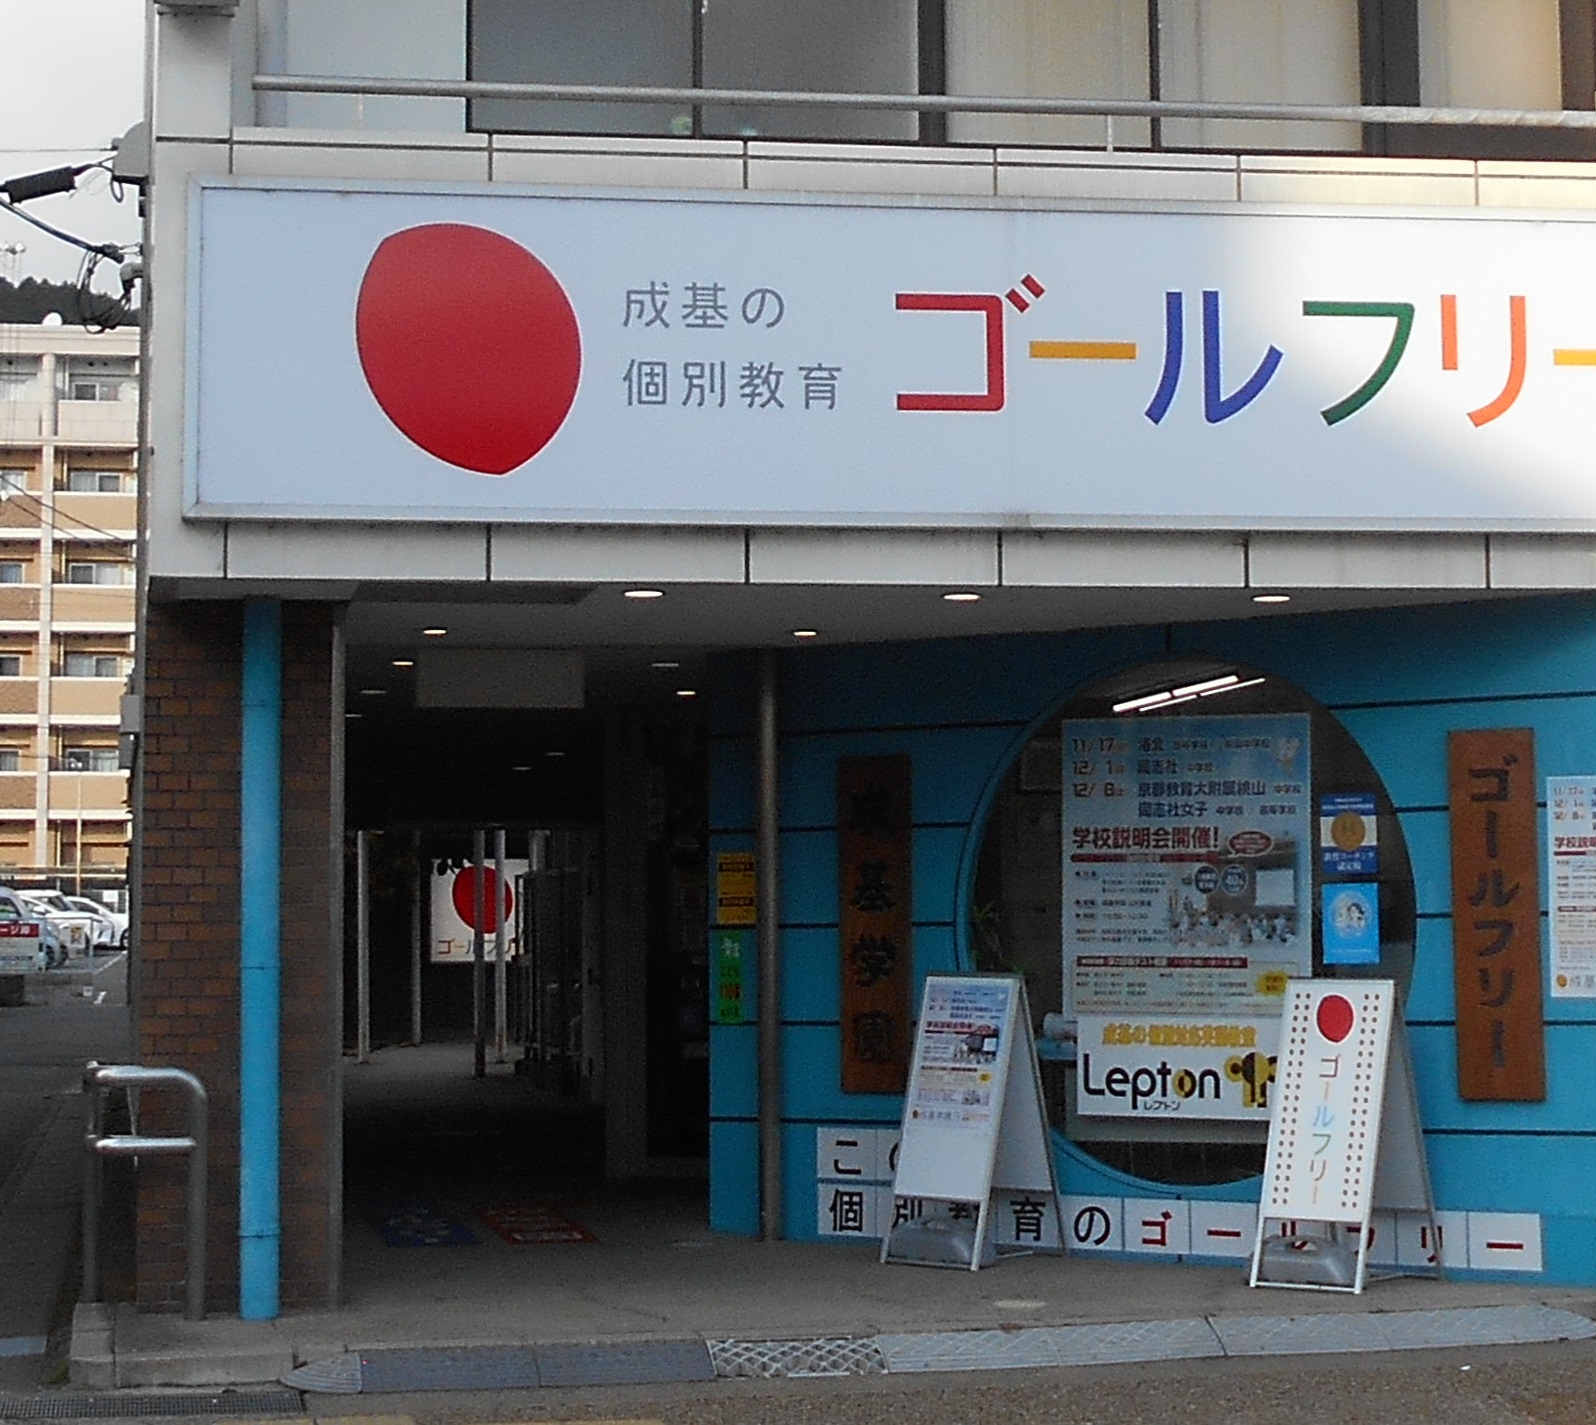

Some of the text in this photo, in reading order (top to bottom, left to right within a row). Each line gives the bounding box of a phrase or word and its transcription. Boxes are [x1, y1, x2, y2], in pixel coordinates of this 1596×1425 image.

[622, 281, 786, 329] 成基の
[622, 359, 843, 411] 個別教育
[1468, 754, 1519, 1067] ゴールフリー
[1083, 1053, 1221, 1110] Lepton
[1310, 1053, 1342, 1204] ゴールフリー
